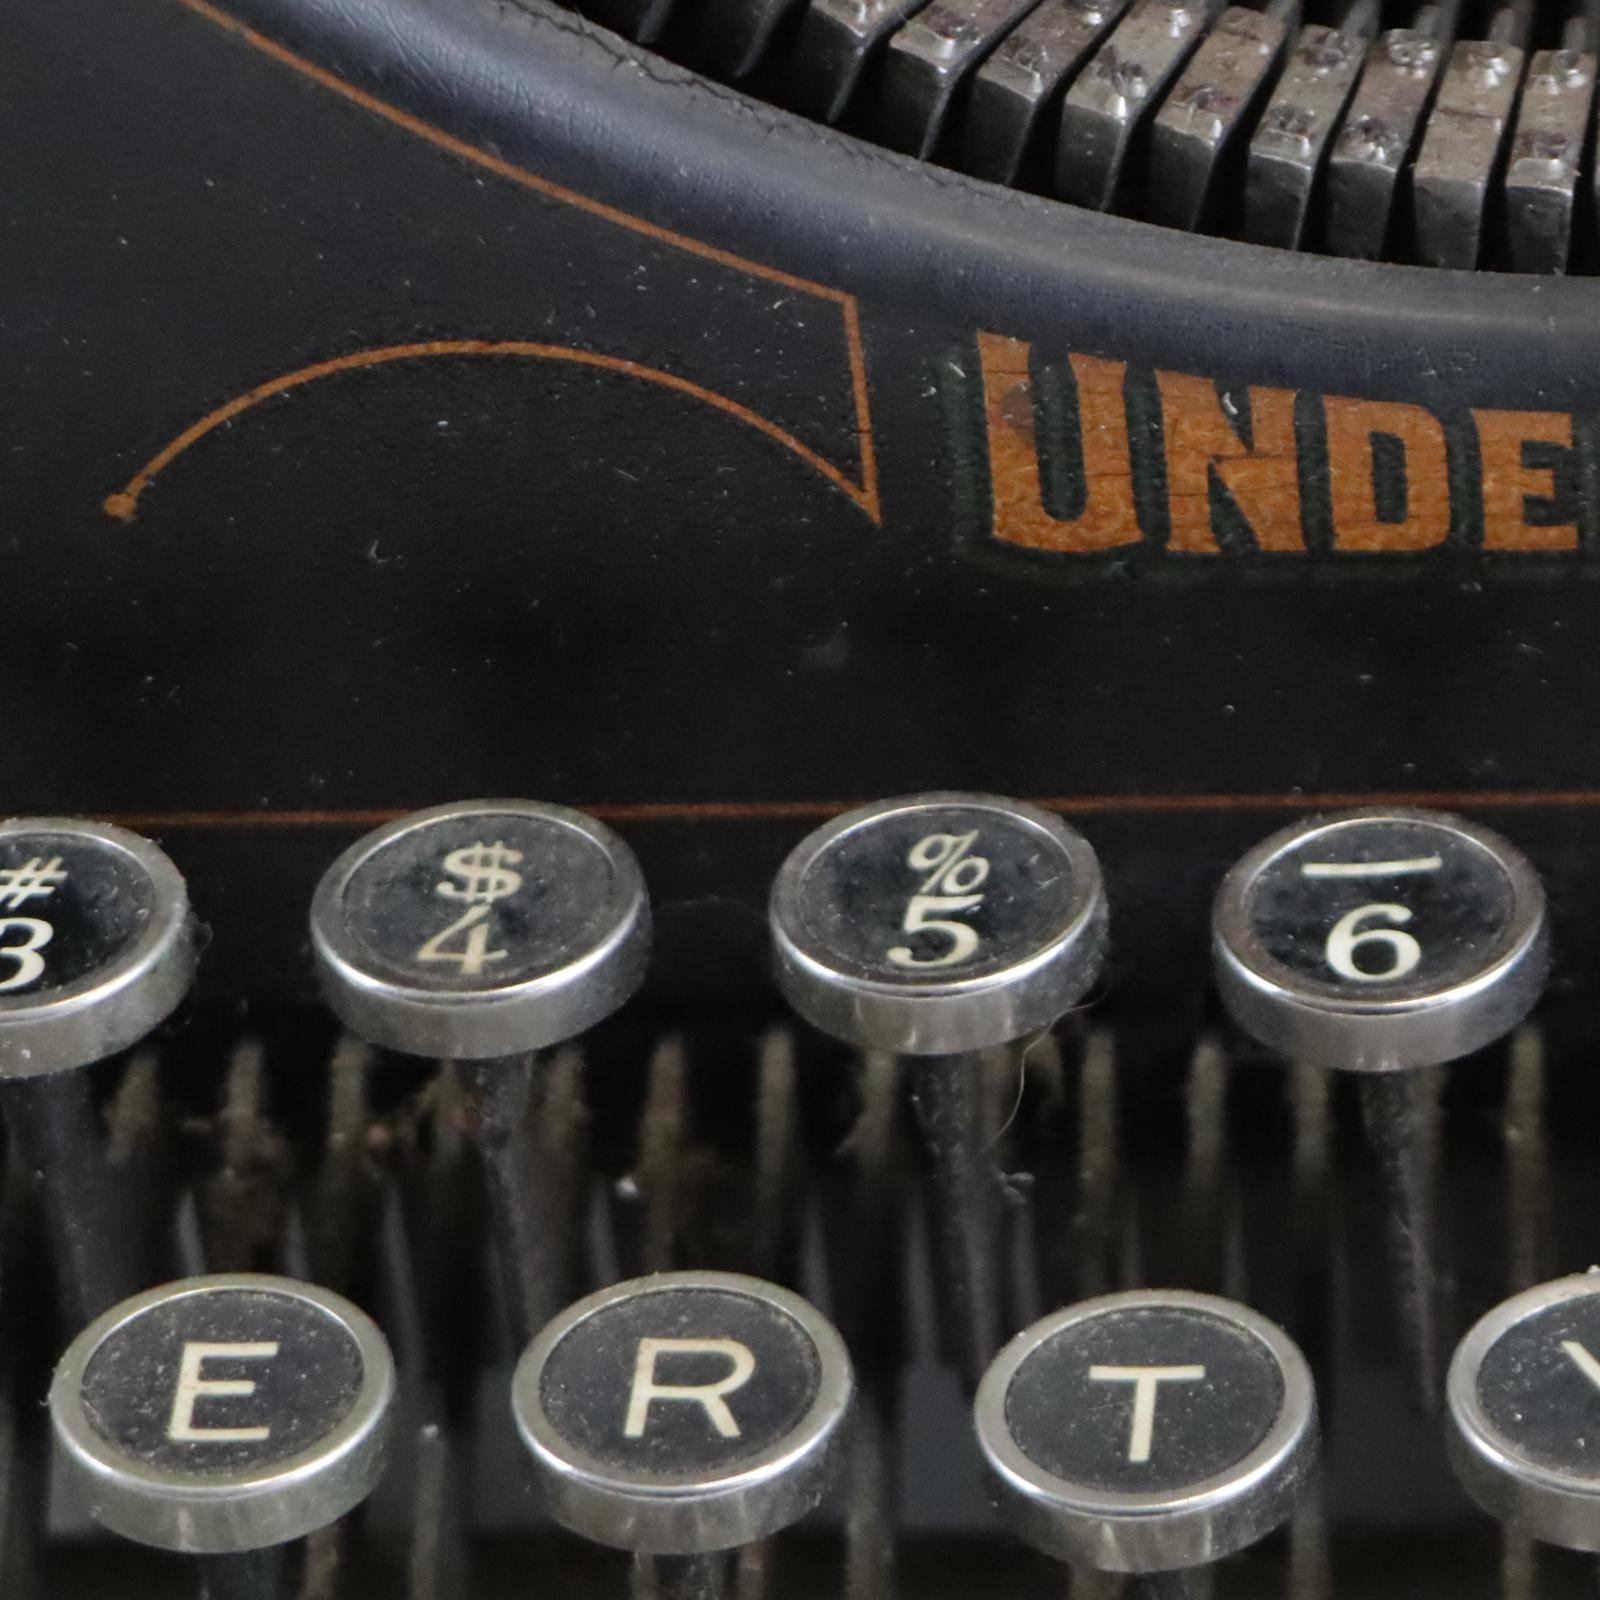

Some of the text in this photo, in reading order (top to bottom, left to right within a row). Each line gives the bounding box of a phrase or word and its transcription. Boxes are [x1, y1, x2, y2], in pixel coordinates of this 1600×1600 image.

[0, 855, 69, 910] #
[435, 839, 525, 904] $
[907, 828, 991, 896] %
[0, 916, 55, 992] 3
[415, 903, 509, 977] 4
[885, 893, 985, 969] 5
[1324, 902, 1422, 983] 6
[166, 1342, 278, 1443] E
[623, 1336, 757, 1439] R
[1087, 1363, 1206, 1464] T
